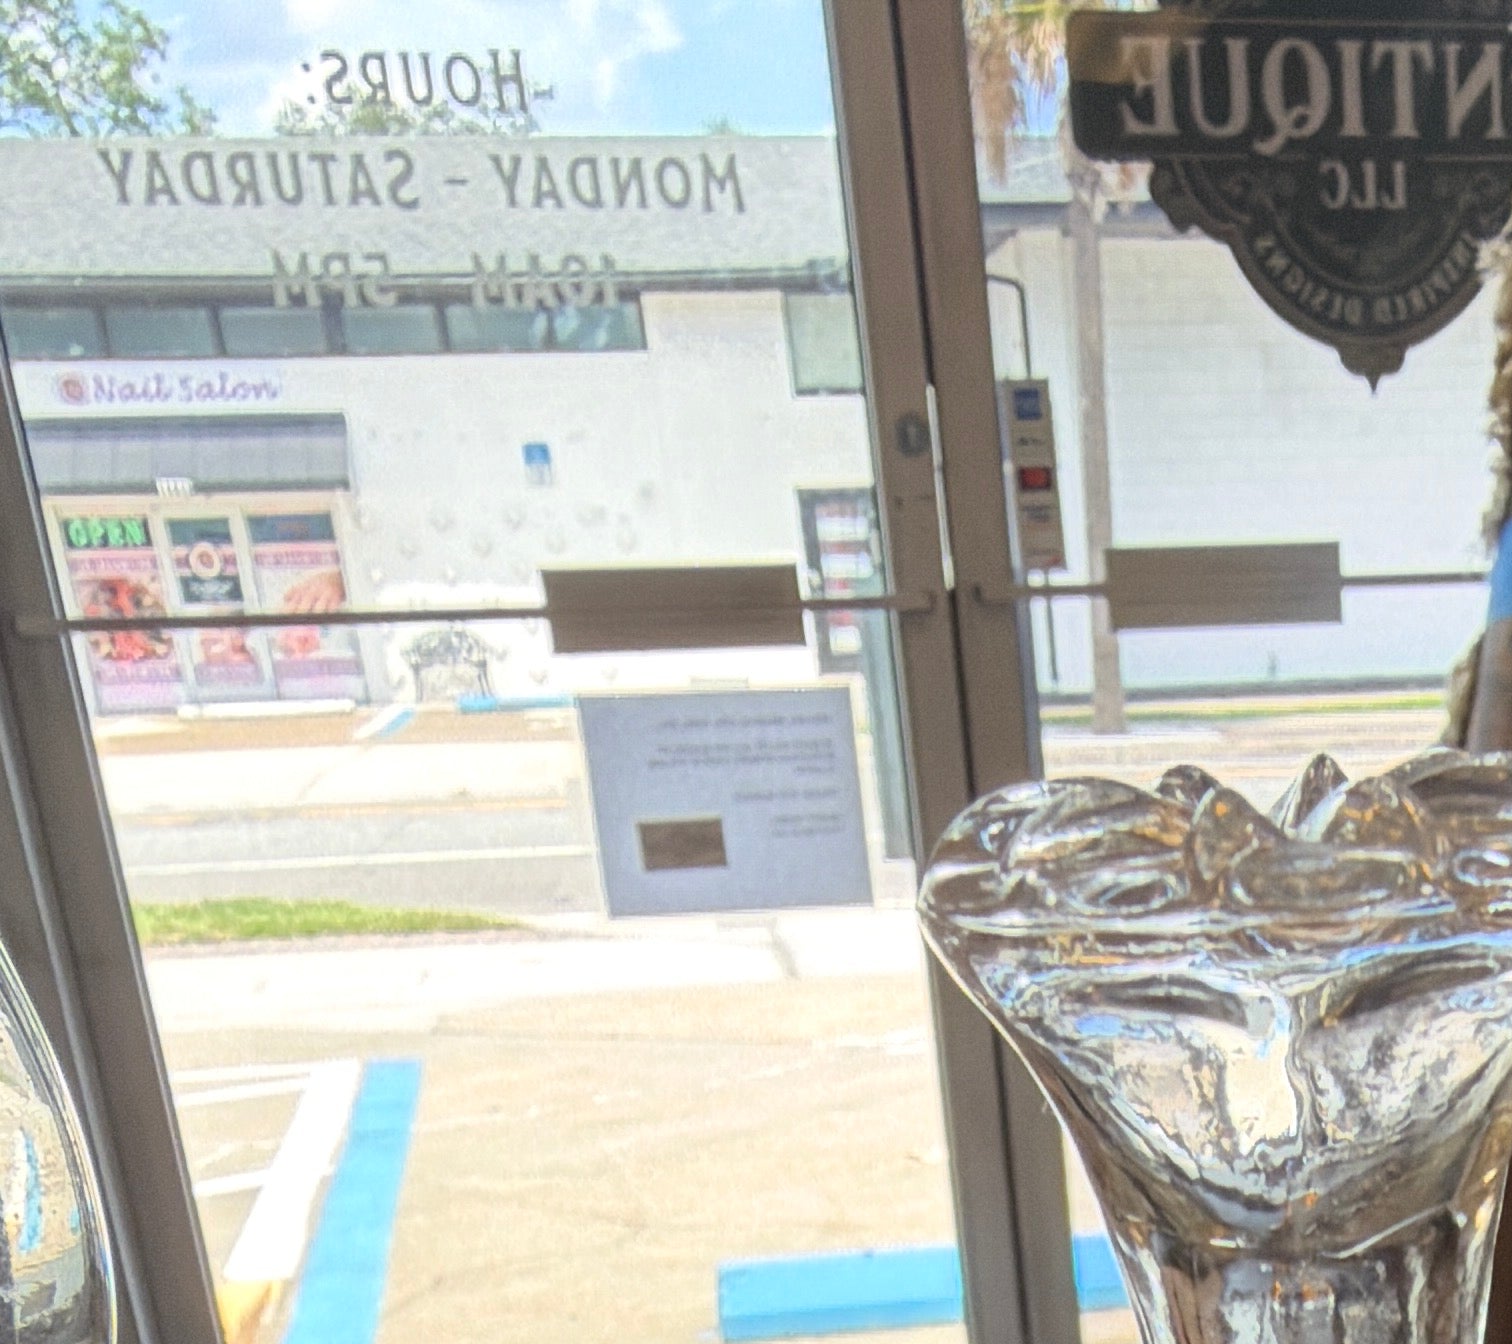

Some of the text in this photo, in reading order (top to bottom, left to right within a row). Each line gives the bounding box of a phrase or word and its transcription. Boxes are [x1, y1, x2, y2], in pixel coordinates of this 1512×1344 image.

[93, 370, 279, 402] Nail Salon
[67, 517, 148, 547] OPEN
